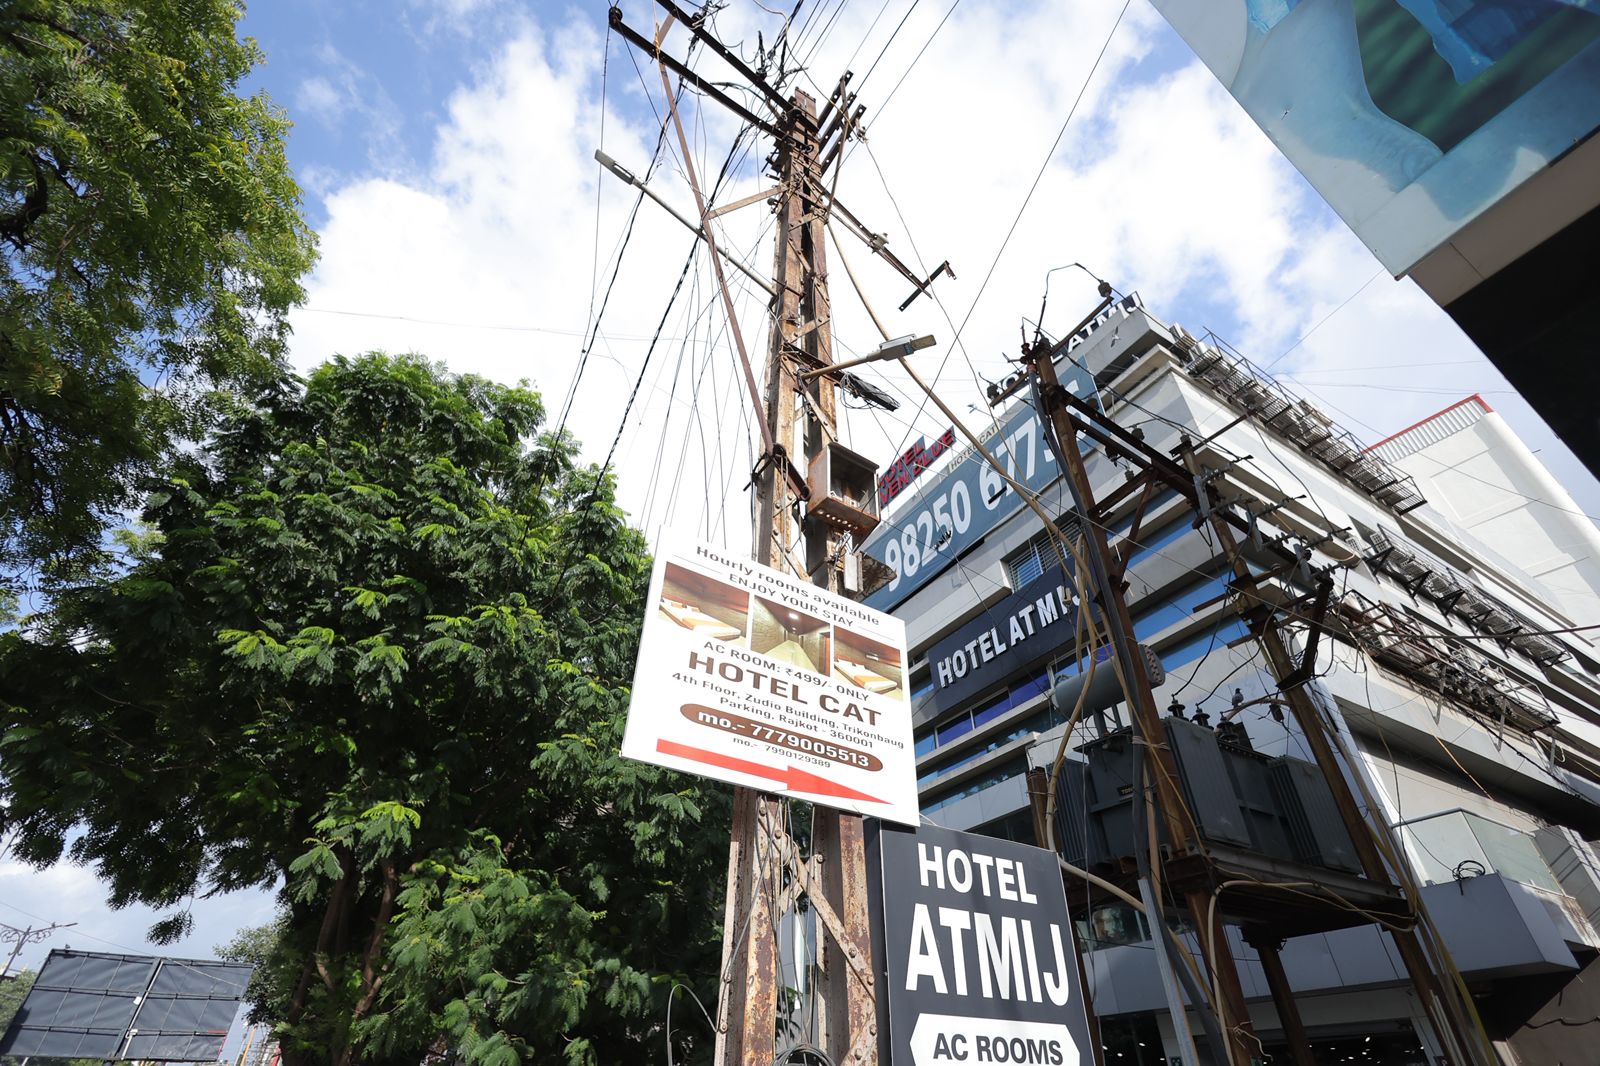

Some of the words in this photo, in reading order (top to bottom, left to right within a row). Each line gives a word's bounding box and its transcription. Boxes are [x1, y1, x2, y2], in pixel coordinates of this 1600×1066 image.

[885, 480, 971, 592] 98250
[696, 546, 753, 576] Hourly
[758, 573, 809, 598] rooms
[813, 594, 880, 626] available
[729, 574, 776, 597] ENJOY
[780, 593, 818, 614] YOUR
[822, 610, 854, 627] STAY
[704, 641, 725, 654] AC
[730, 649, 780, 673] ROOM:
[836, 685, 869, 702] ONLY
[937, 627, 1006, 688] HOTEL
[672, 672, 697, 686] 4th
[745, 693, 781, 711] Zudio
[785, 706, 839, 729] Building,
[842, 723, 904, 749] Trikonbaug
[689, 651, 808, 705] HOTEL
[819, 694, 882, 726] CAT
[720, 697, 775, 720] Parking,
[779, 714, 818, 732] Rajkot
[830, 729, 873, 748] 360001
[750, 723, 870, 767] 7779005513
[765, 745, 831, 768] 7990129389
[917, 842, 1038, 904] HOTEL
[905, 903, 1069, 1006] ATMIJ
[933, 1032, 968, 1061] AC
[976, 1035, 1064, 1066] ROOMS
